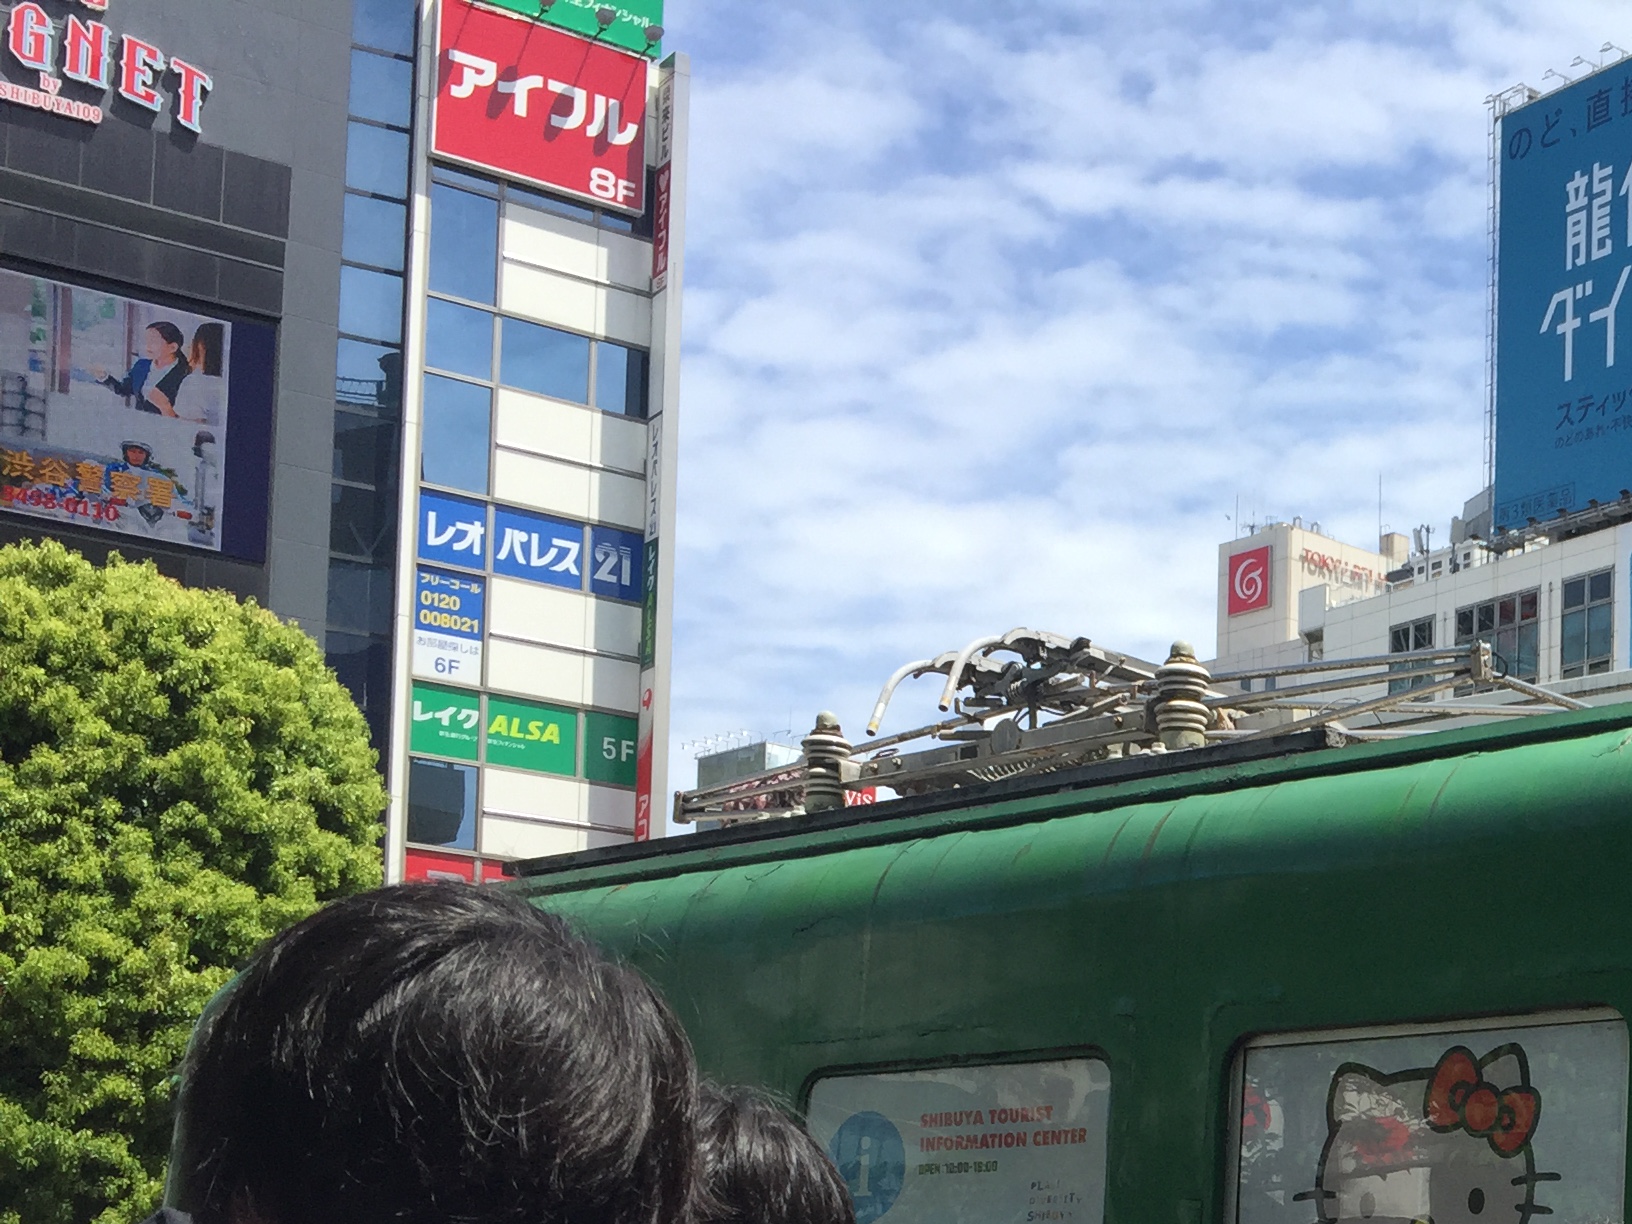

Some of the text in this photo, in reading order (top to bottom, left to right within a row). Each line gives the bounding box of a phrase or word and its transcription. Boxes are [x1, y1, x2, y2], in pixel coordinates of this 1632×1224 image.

[8, 2, 213, 133] GNET
[40, 73, 62, 94] by
[0, 82, 103, 124] SHIBUYA109
[449, 49, 638, 145] アイフル
[589, 167, 636, 202] 8F
[656, 191, 669, 272] アイフル
[2, 450, 175, 508] 渋谷警察署
[420, 573, 481, 594] フリーコール
[421, 590, 460, 610] 0120
[419, 609, 479, 633] 008021
[434, 657, 460, 674] 6F
[602, 737, 634, 762] 5F
[920, 1105, 1053, 1128] SHIBUYA TOURIST
[920, 1127, 1087, 1152] INFORMATION CENTER
[918, 1163, 940, 1175] OPEN
